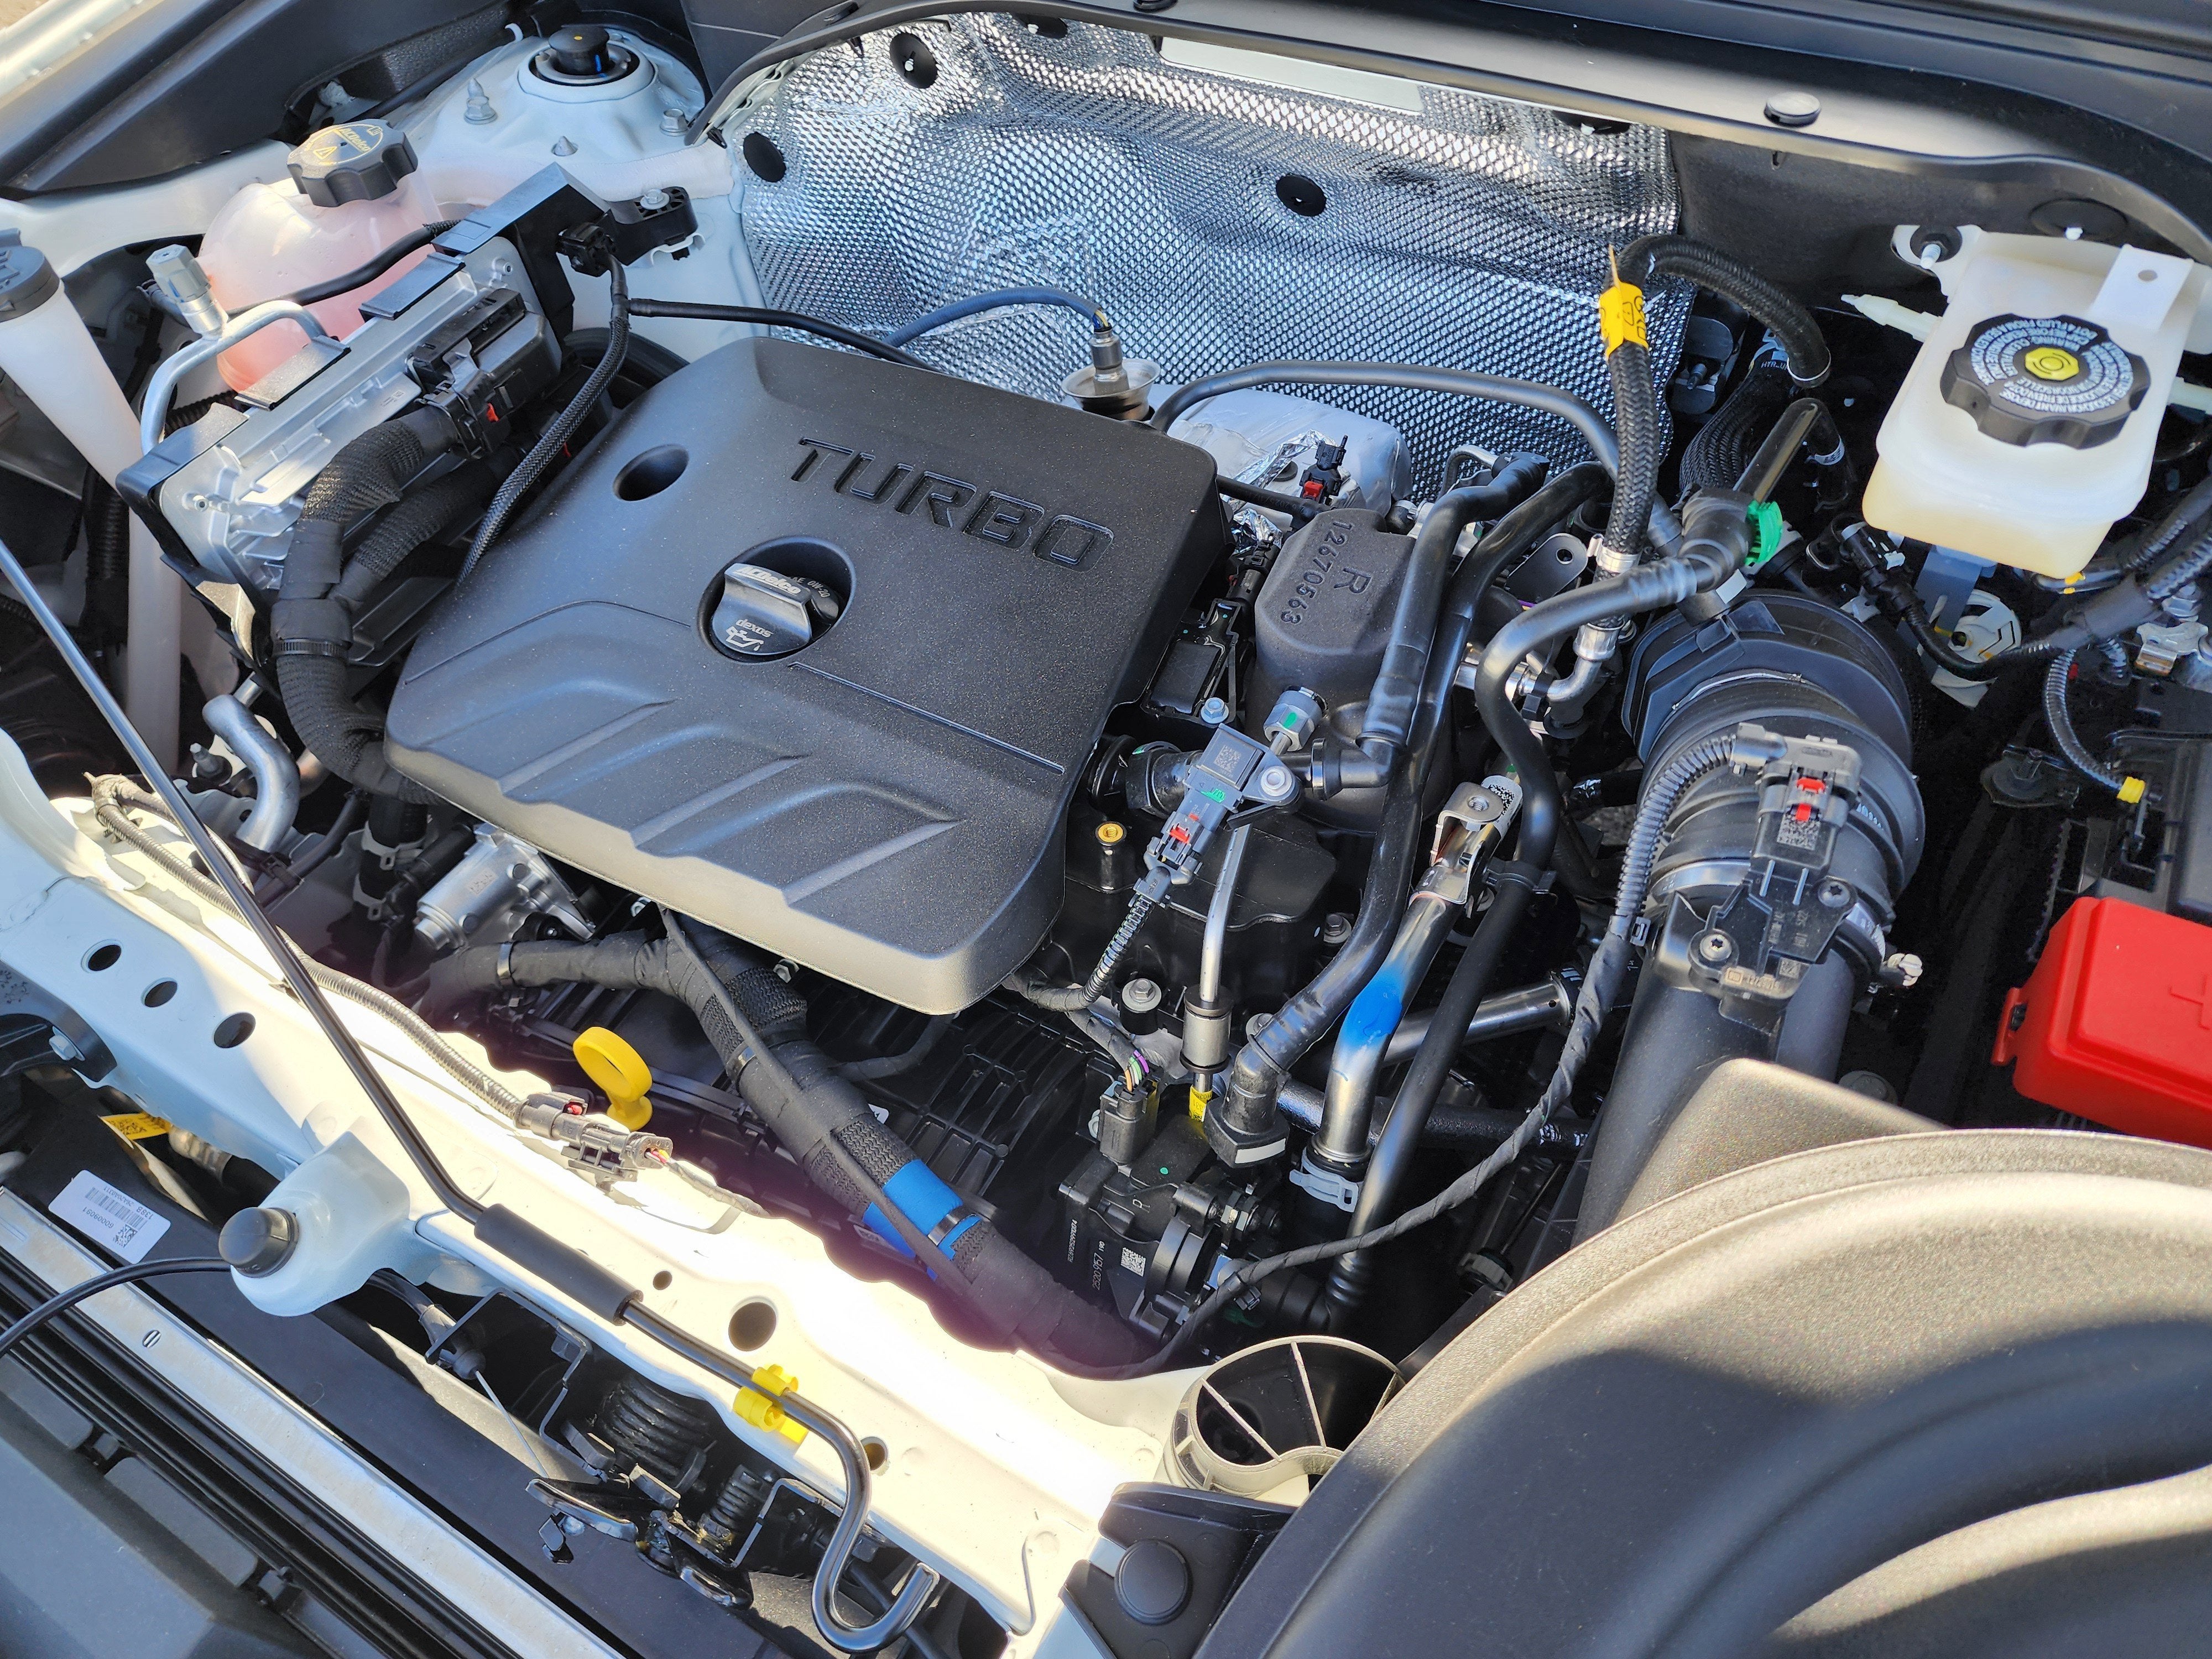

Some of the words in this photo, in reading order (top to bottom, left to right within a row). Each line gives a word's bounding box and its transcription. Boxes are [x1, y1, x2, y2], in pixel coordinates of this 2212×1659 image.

[2002, 319, 2036, 331] FROM
[2024, 327, 2068, 338] BEFORE
[2033, 319, 2068, 330] FLUID
[1973, 327, 2005, 350] SEALED
[2065, 331, 2092, 346] CAP
[790, 436, 1115, 572] TURBO
[733, 566, 801, 596] ACDelco
[1280, 521, 1354, 624] 12670563
[1334, 566, 1373, 595] R
[735, 619, 774, 638] dexos
[137, 1206, 154, 1219] 138B
